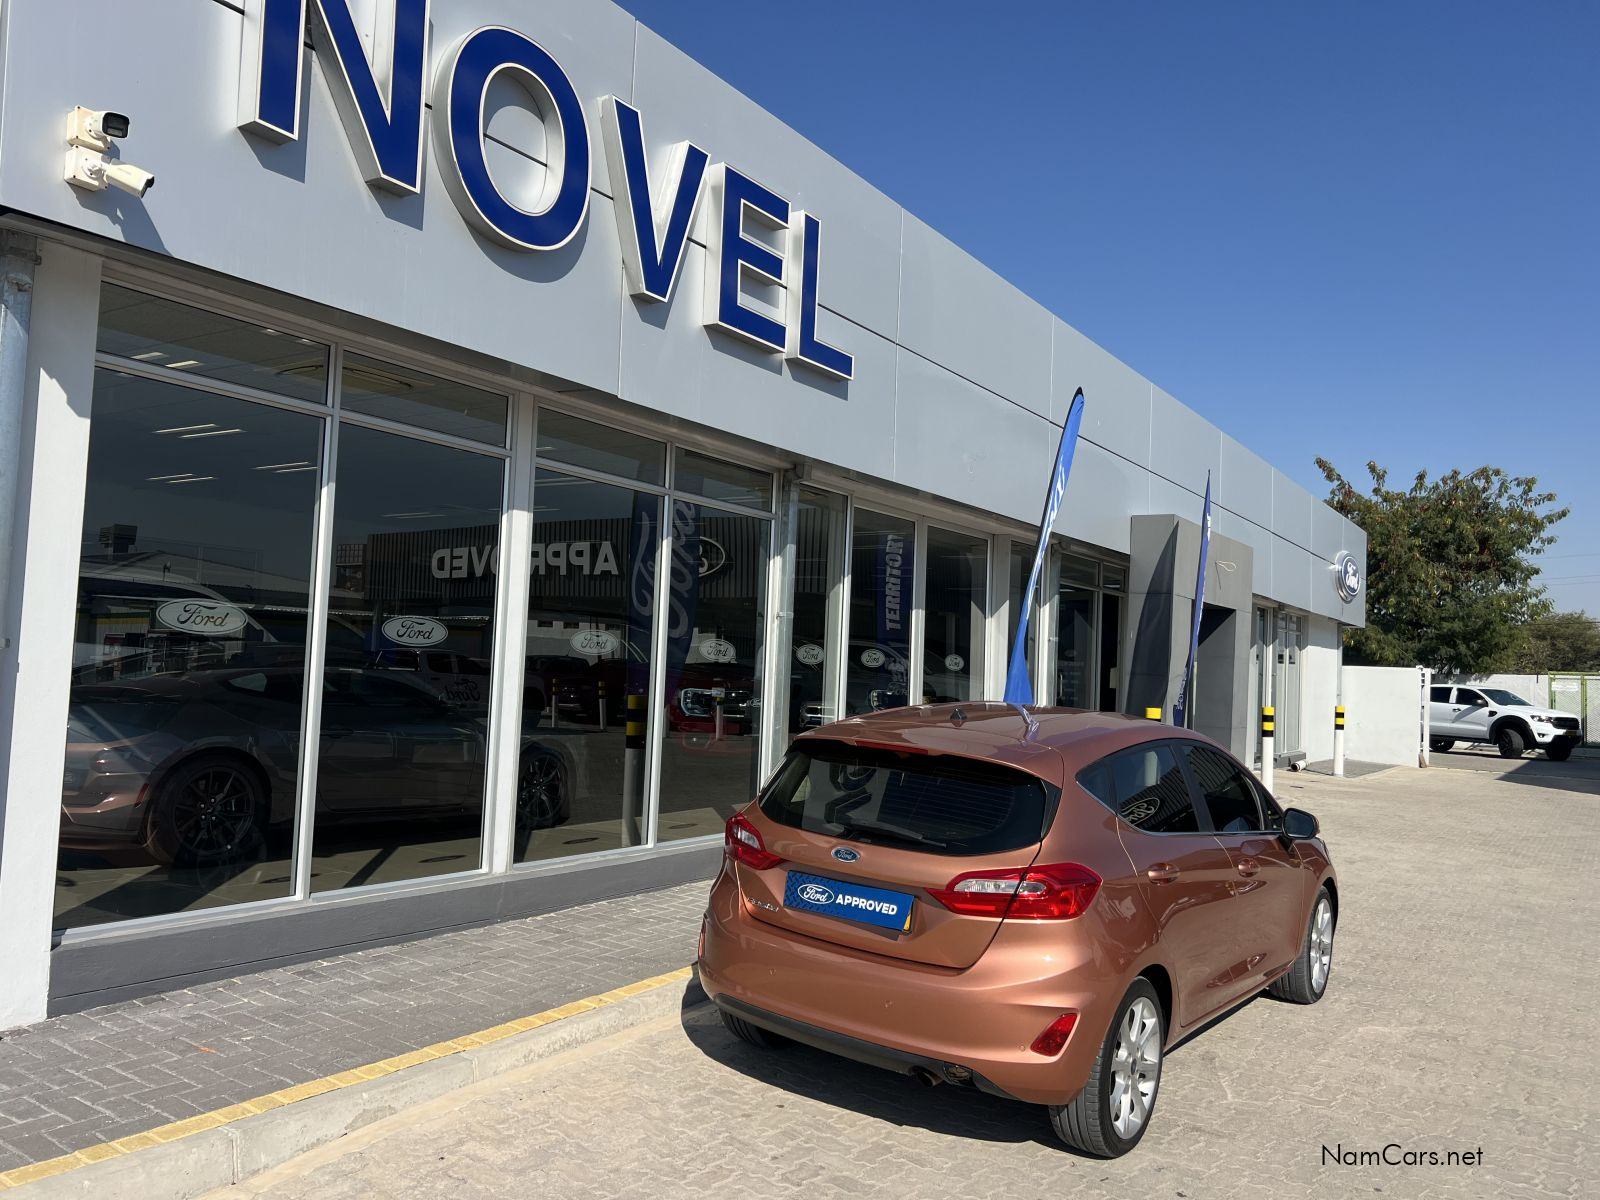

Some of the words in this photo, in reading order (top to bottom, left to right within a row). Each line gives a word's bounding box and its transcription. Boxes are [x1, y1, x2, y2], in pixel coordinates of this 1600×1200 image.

[238, 0, 854, 381] NOVEL
[177, 602, 229, 627] Ford
[396, 620, 434, 640] Ford
[581, 634, 608, 650] Ford
[707, 642, 729, 657] Ford
[802, 647, 819, 660] Ford
[865, 652, 880, 664] Ford
[803, 885, 829, 903] Ford
[836, 893, 898, 916] APPROVED
